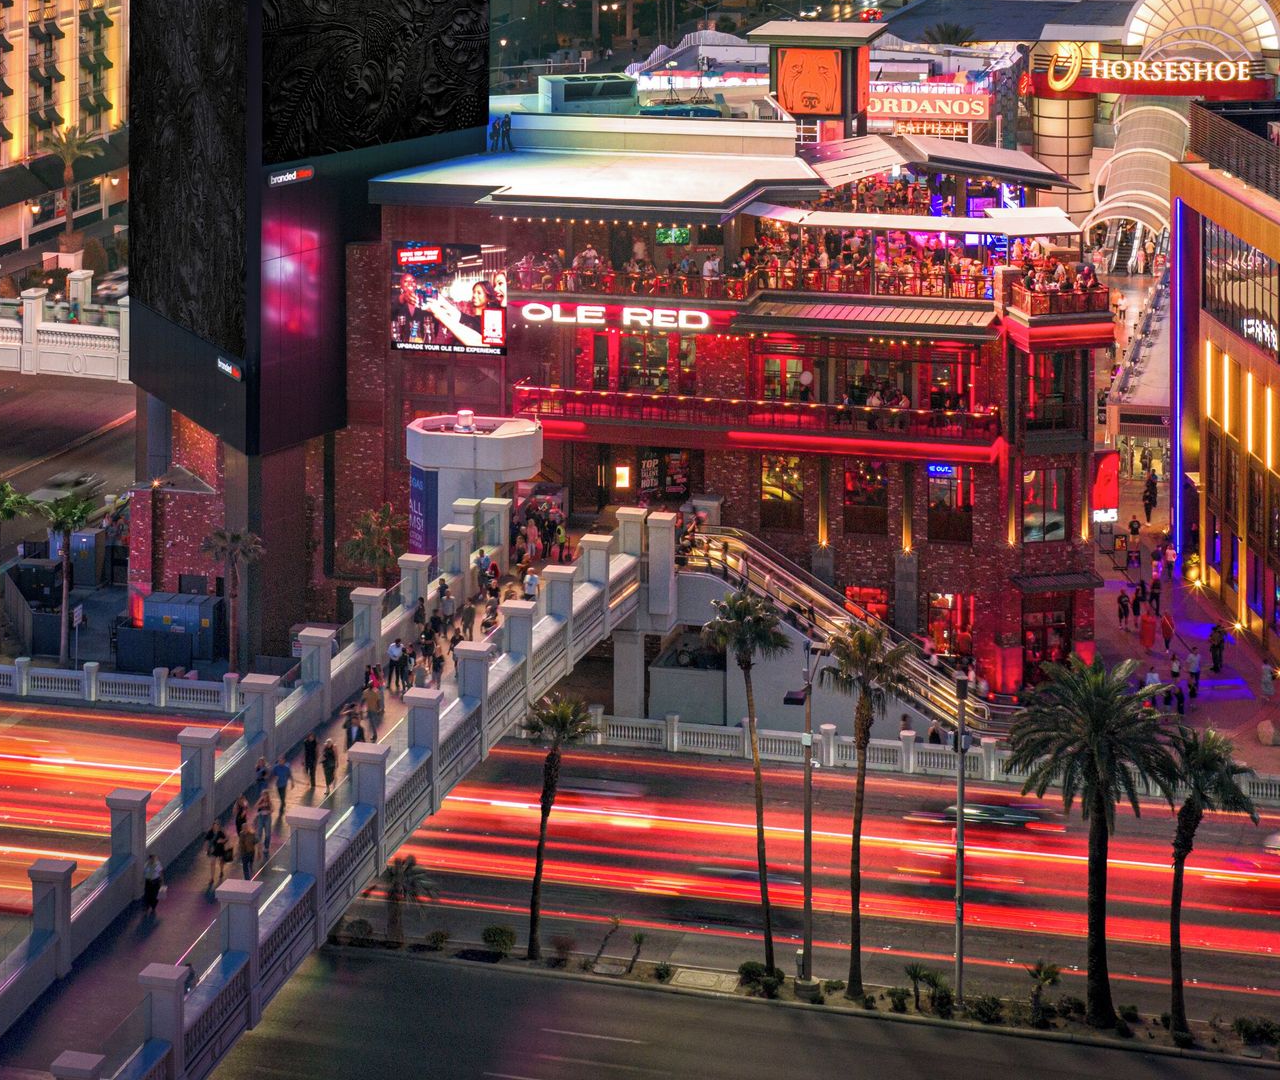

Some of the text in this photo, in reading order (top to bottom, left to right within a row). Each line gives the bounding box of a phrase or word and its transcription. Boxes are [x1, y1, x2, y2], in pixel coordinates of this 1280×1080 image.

[1090, 59, 1251, 82] HORSESHOE
[521, 302, 710, 329] OLE RED
[466, 347, 501, 355] EXPERIENCE
[641, 459, 659, 469] TOP
